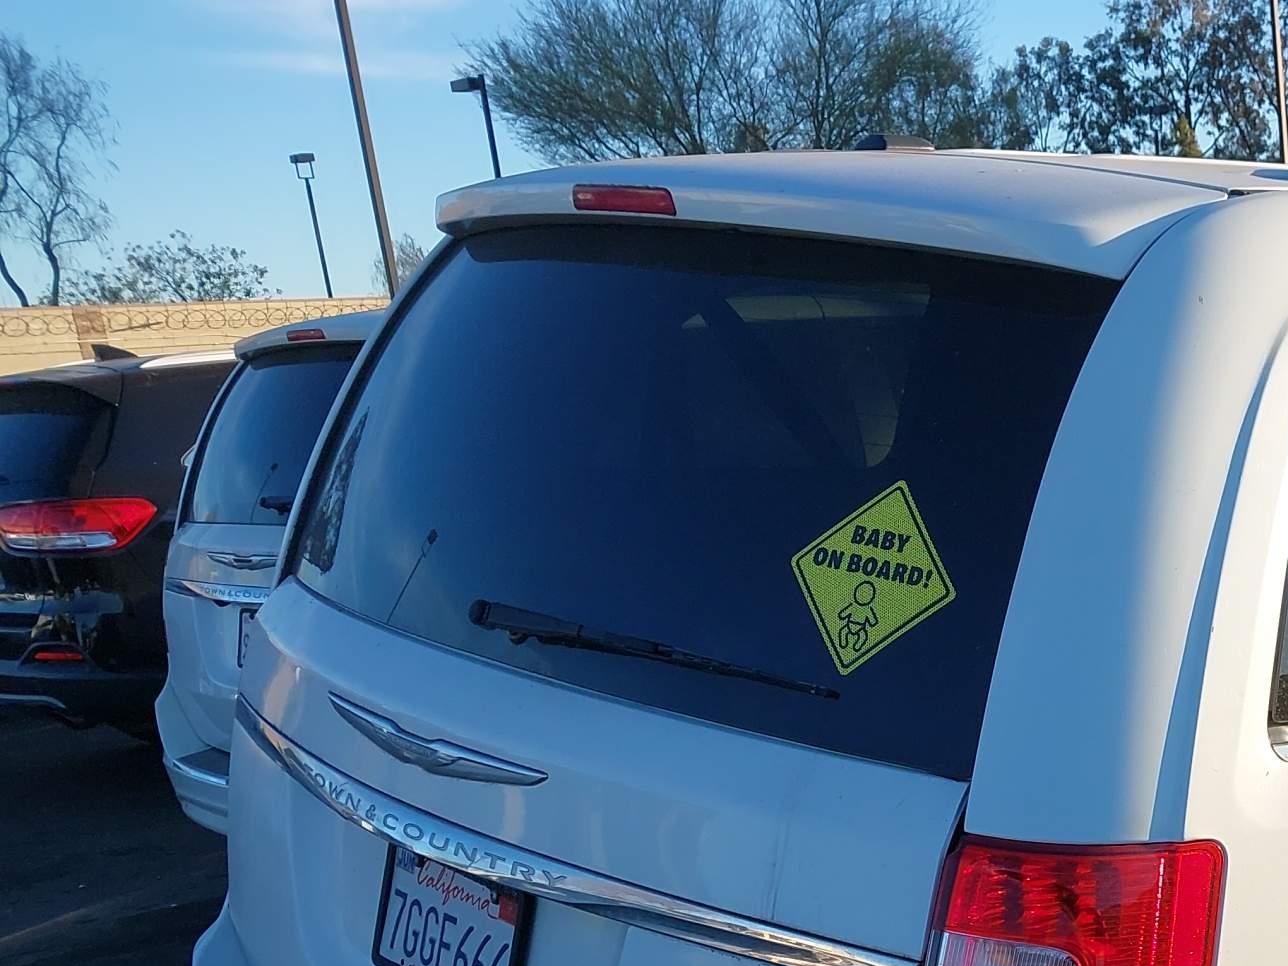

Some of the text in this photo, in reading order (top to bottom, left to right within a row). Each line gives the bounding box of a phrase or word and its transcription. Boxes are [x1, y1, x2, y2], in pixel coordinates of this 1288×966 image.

[851, 525, 912, 553] BABY
[813, 547, 933, 589] ON BOARD!
[383, 813, 567, 888] COUNTRY
[417, 858, 498, 919] California
